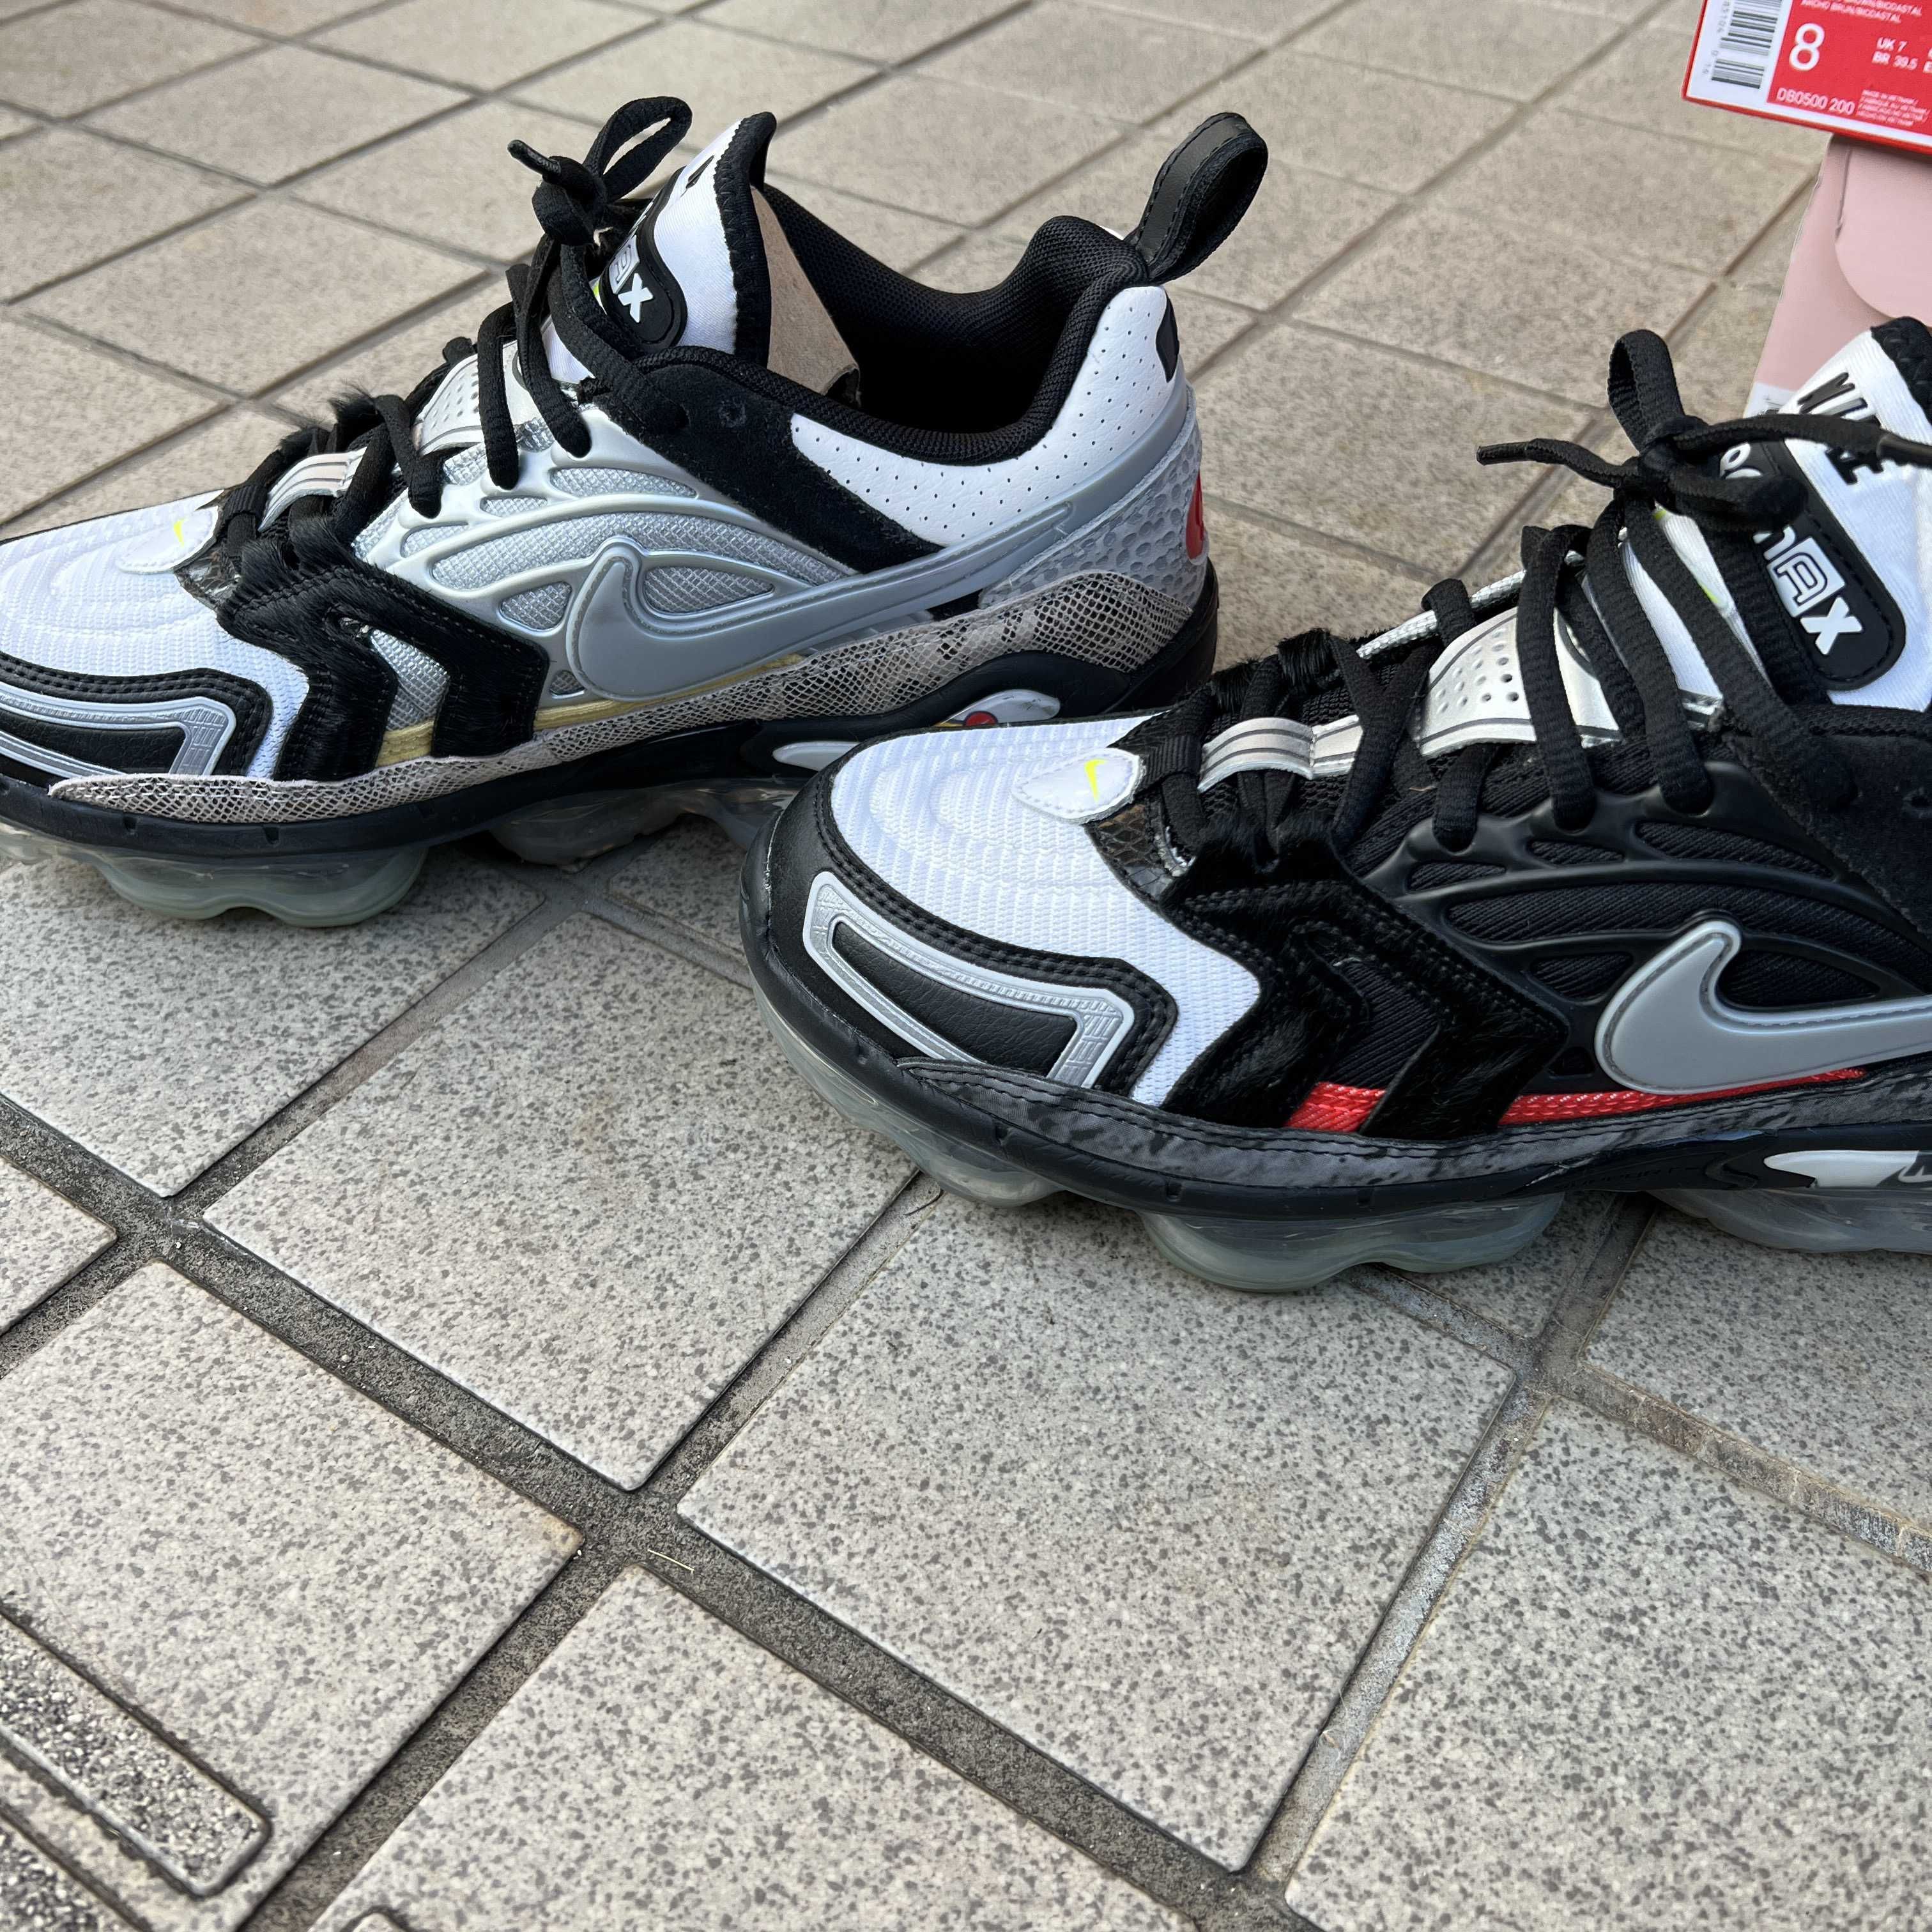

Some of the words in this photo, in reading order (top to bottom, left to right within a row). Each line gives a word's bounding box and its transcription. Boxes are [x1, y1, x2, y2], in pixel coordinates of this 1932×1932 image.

[1789, 22, 1825, 72] 8
[1876, 36, 1896, 51] UK
[1897, 40, 1908, 52] 7
[1871, 50, 1891, 65] BR
[1775, 87, 1828, 111] DB0500
[1828, 97, 1856, 116] 200
